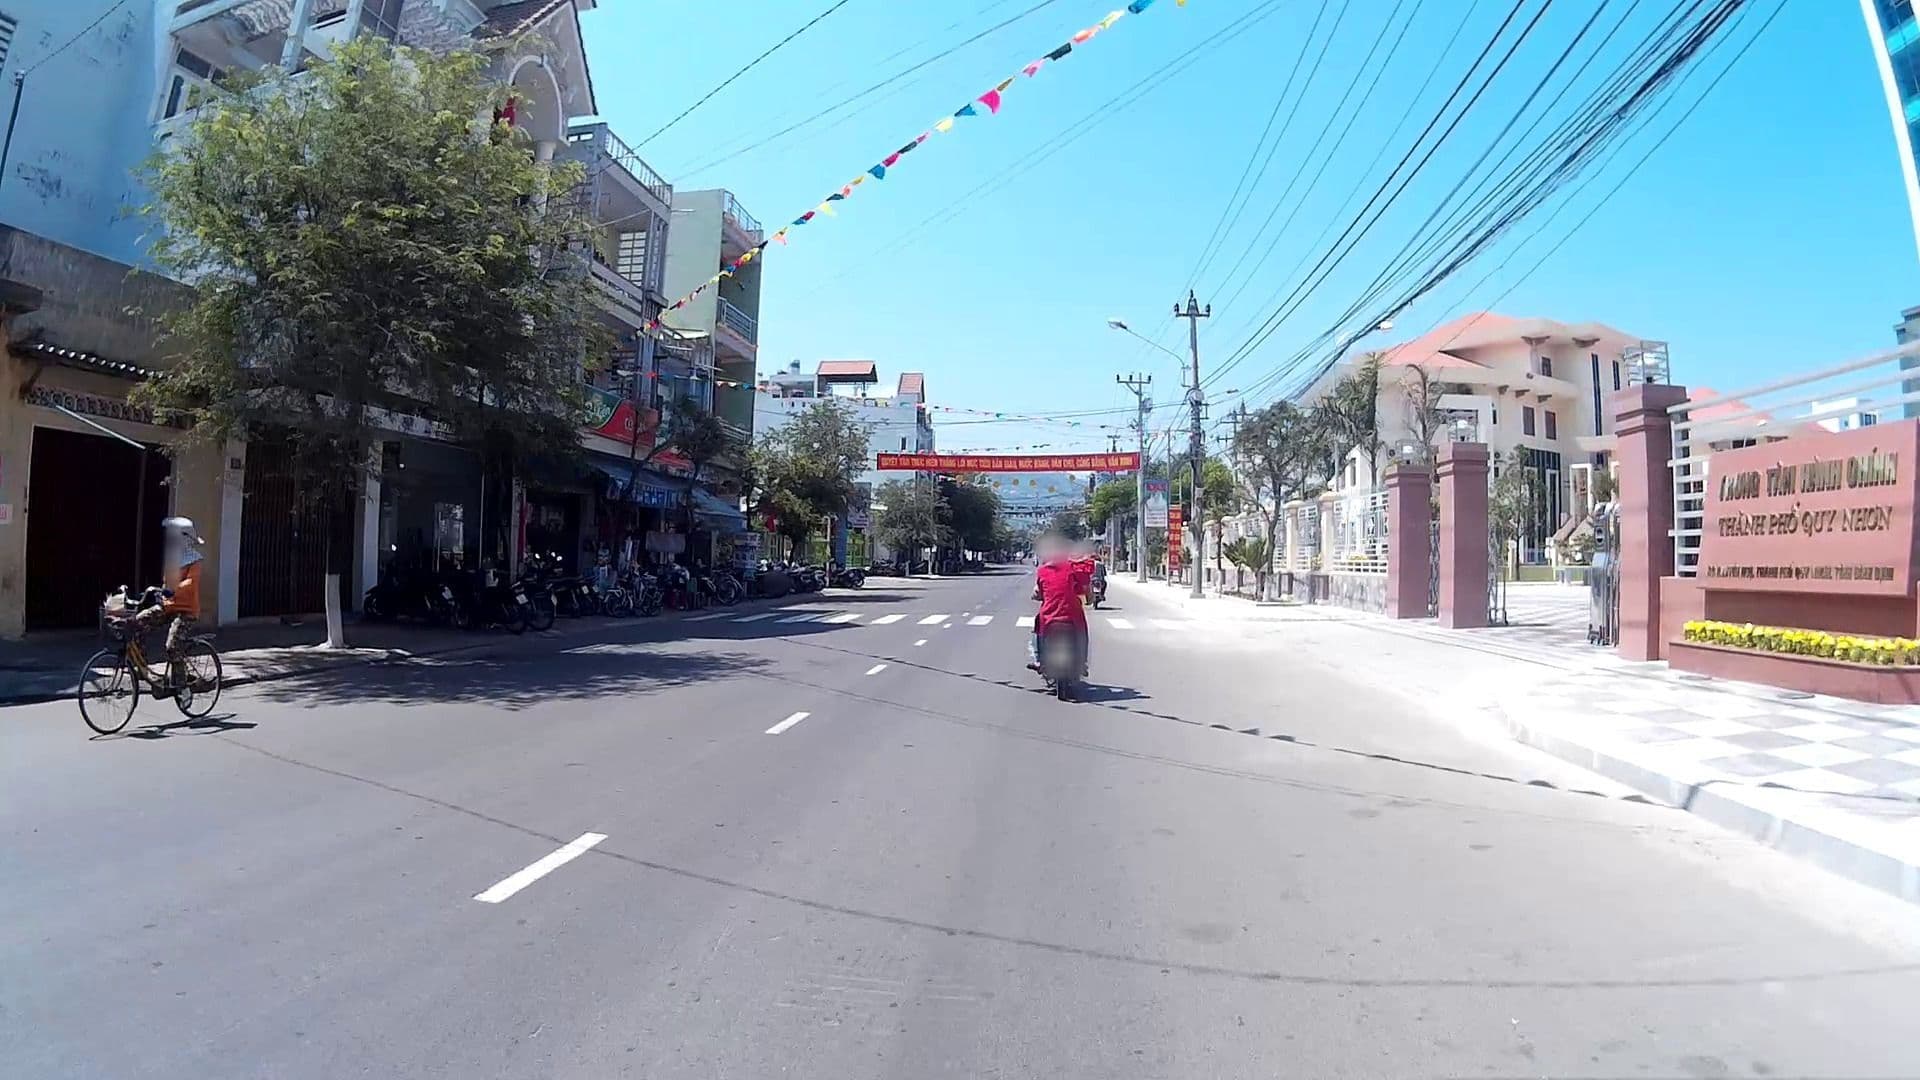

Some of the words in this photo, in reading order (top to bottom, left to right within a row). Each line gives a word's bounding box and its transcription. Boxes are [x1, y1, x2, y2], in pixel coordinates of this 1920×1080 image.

[1766, 460, 1797, 498] TÂM
[1800, 455, 1843, 494] HÀNH
[1718, 510, 1767, 537] THÀNH
[1768, 501, 1800, 536] PHỐ
[1801, 509, 1838, 537] QUY
[1841, 504, 1892, 532] NHƠN
